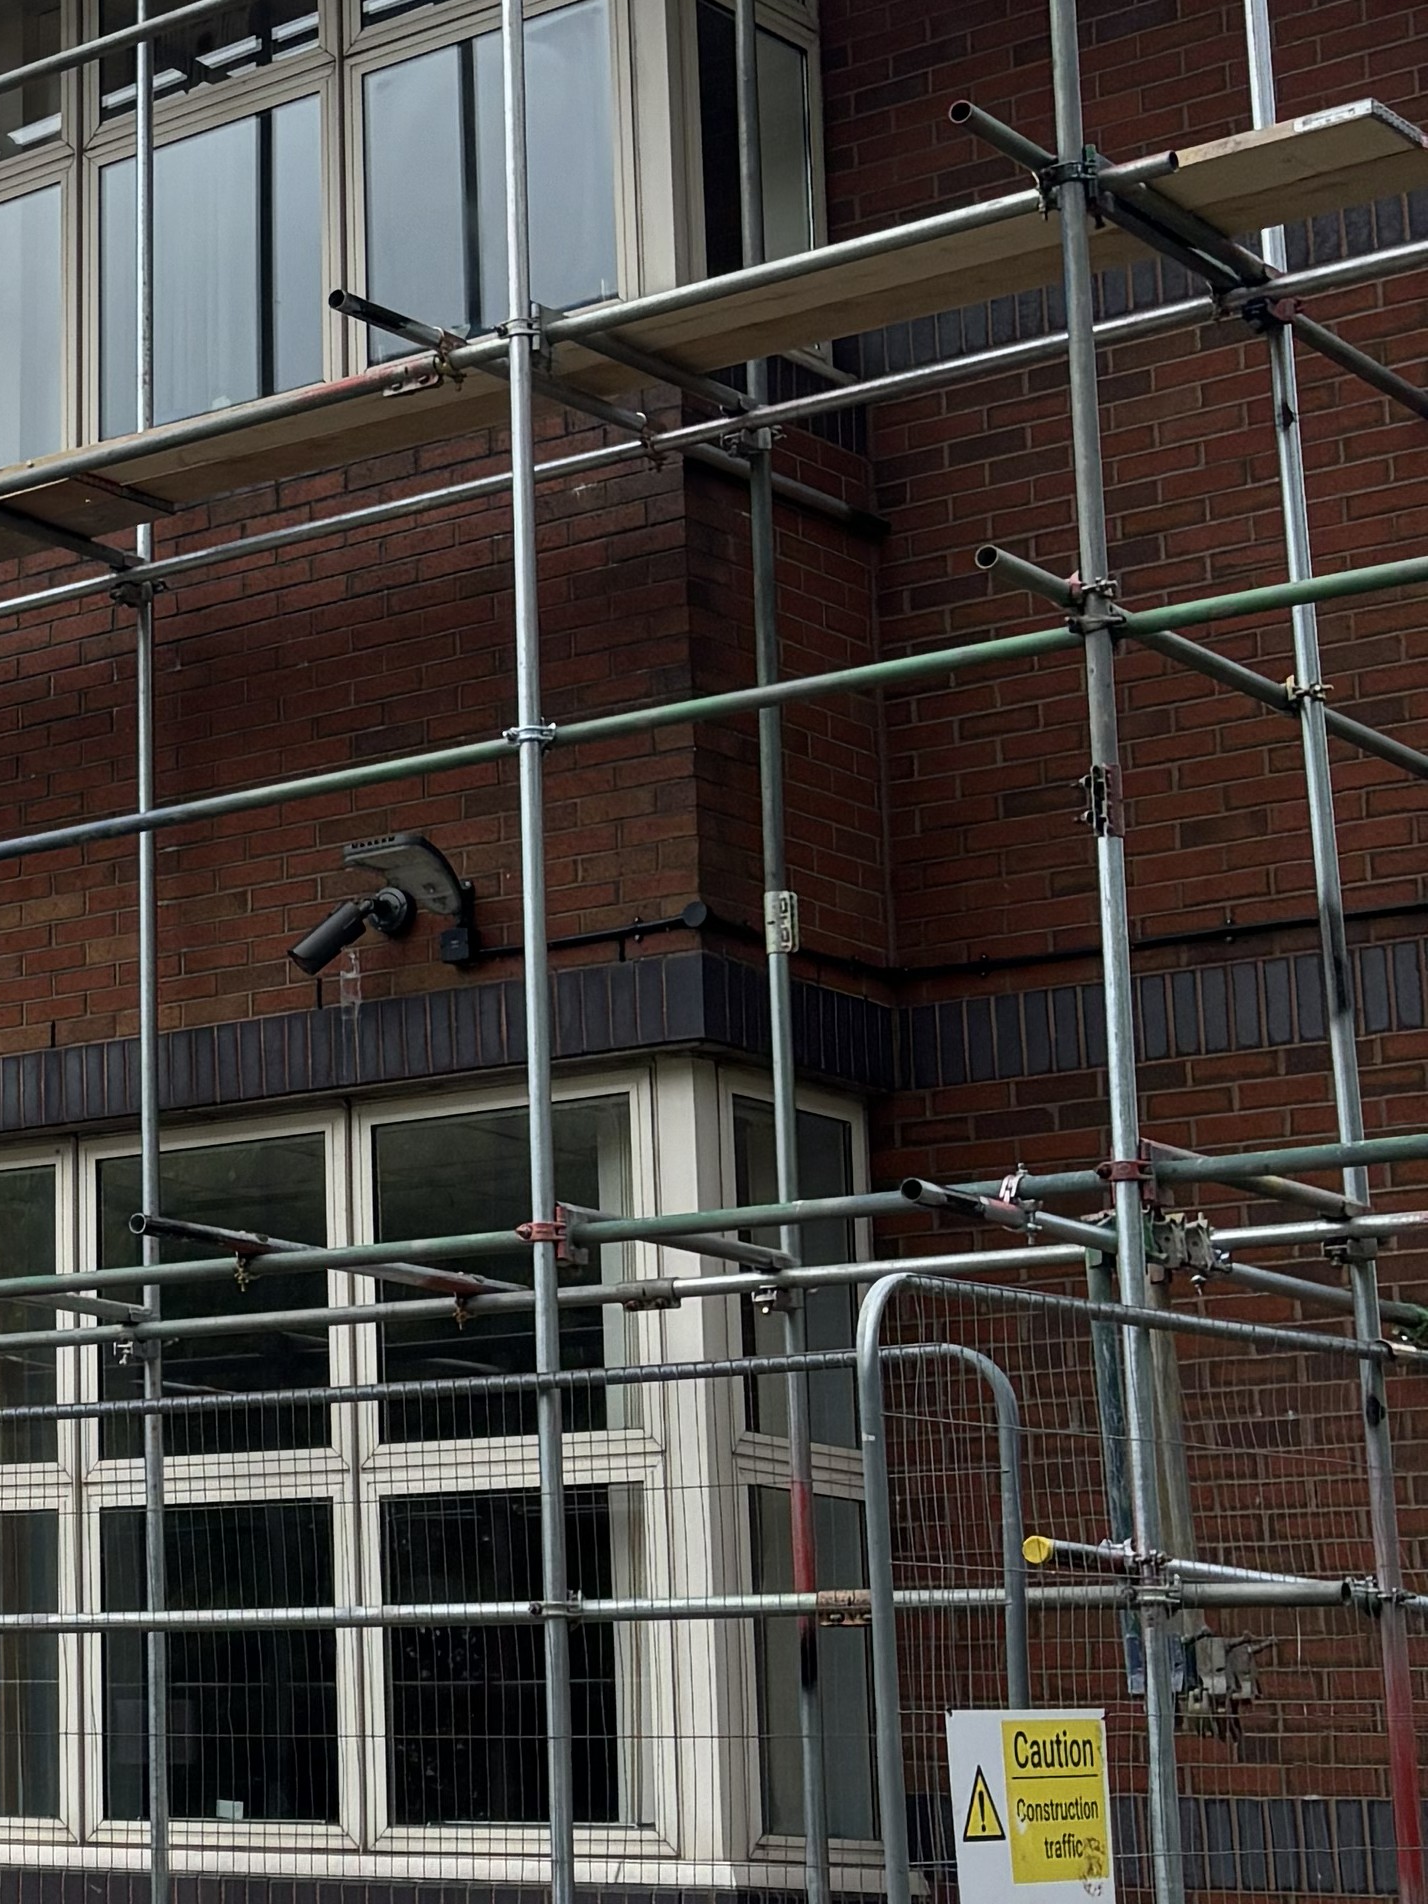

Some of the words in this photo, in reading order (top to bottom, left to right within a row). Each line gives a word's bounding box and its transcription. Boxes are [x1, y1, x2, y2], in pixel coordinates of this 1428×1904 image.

[1013, 1729, 1095, 1769] Caution
[1016, 1795, 1099, 1824] Construction
[1044, 1832, 1084, 1860] traffic
